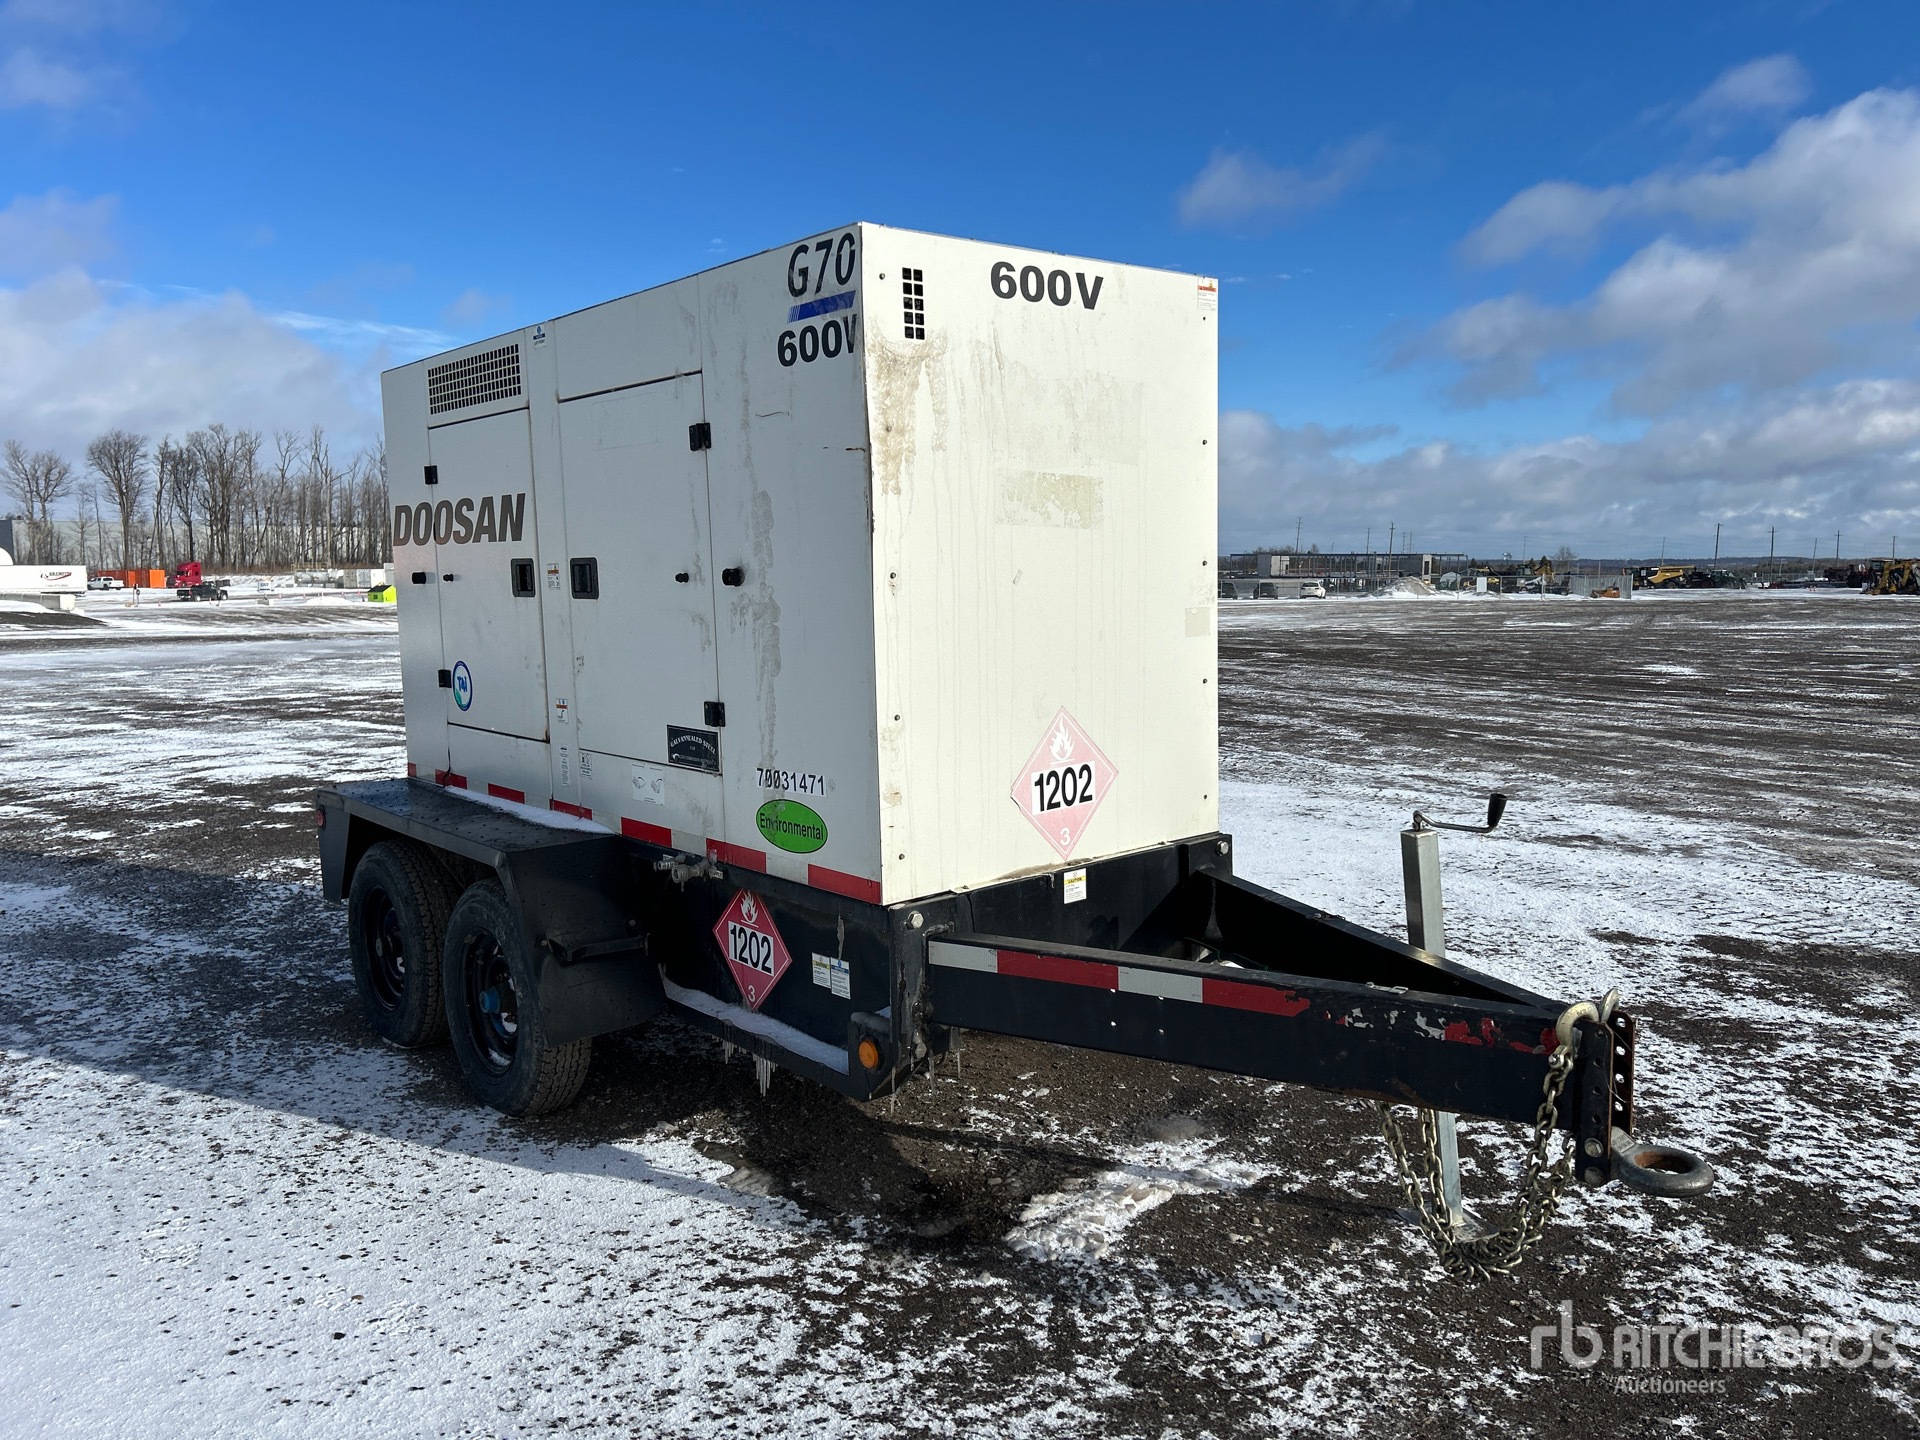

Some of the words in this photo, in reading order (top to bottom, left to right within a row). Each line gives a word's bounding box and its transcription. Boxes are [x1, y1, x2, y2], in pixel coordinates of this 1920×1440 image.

[787, 232, 856, 297] G70
[989, 261, 1104, 310] 600V
[777, 313, 857, 367] 600V
[393, 493, 526, 546] DOOSAN
[1034, 764, 1093, 812] 1202
[760, 813, 824, 841] Environmental
[1060, 827, 1071, 846] 3
[730, 924, 773, 975] 1202
[748, 984, 756, 1003] 3
